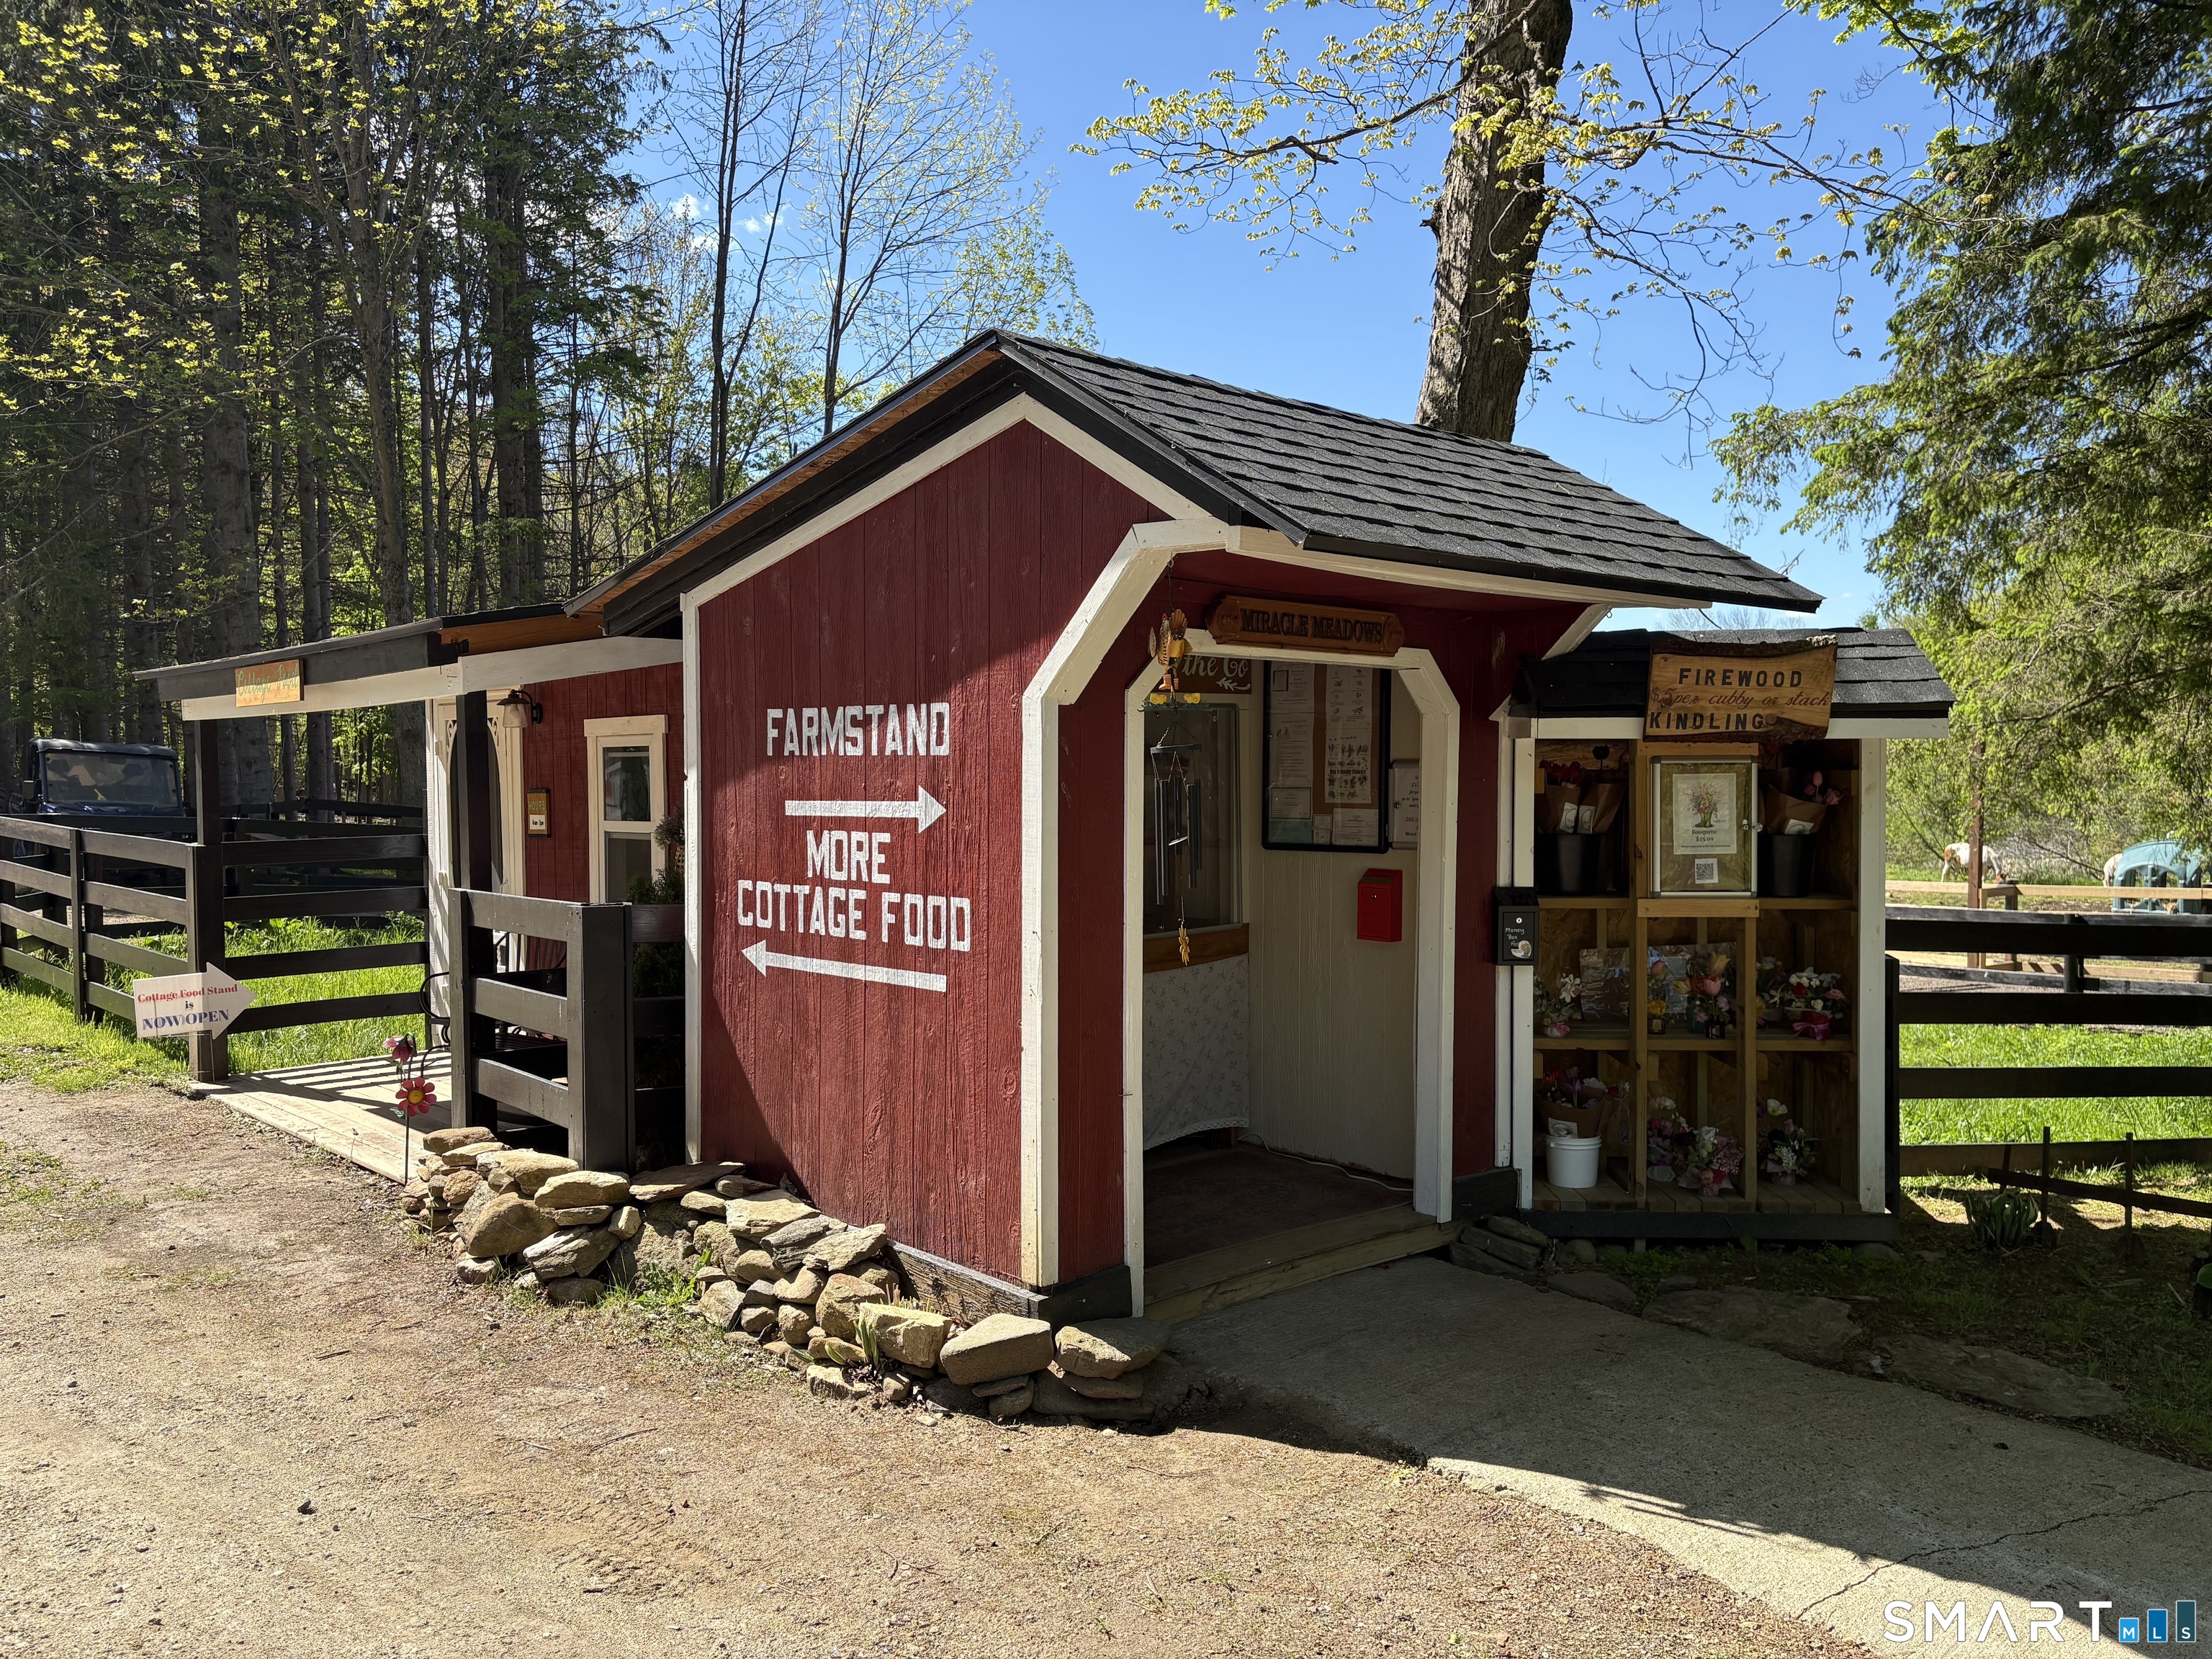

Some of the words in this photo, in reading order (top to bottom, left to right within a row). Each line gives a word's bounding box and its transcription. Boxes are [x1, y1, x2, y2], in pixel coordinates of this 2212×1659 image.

[1241, 608, 1308, 637] MIRACLE
[1311, 615, 1383, 644] MEADOWS
[1182, 655, 1218, 677] the
[237, 670, 271, 703] Cottage
[276, 662, 300, 691] Food
[1678, 668, 1803, 688] FIREWOOD
[1708, 690, 1754, 710] cubby
[1761, 695, 1779, 706] or
[1785, 691, 1830, 706] stack
[767, 702, 950, 756] FARMSTAND
[1649, 711, 1763, 730] KINDLING
[528, 800, 546, 811] HOURS
[806, 830, 891, 884] MORE
[737, 880, 867, 940] COTTAGE
[881, 892, 971, 952] FOOD
[138, 992, 179, 1002] Cottage
[180, 988, 205, 999] Food
[207, 984, 238, 995] Stand
[143, 1014, 181, 1030] NOW
[185, 1010, 229, 1025] OPEN
